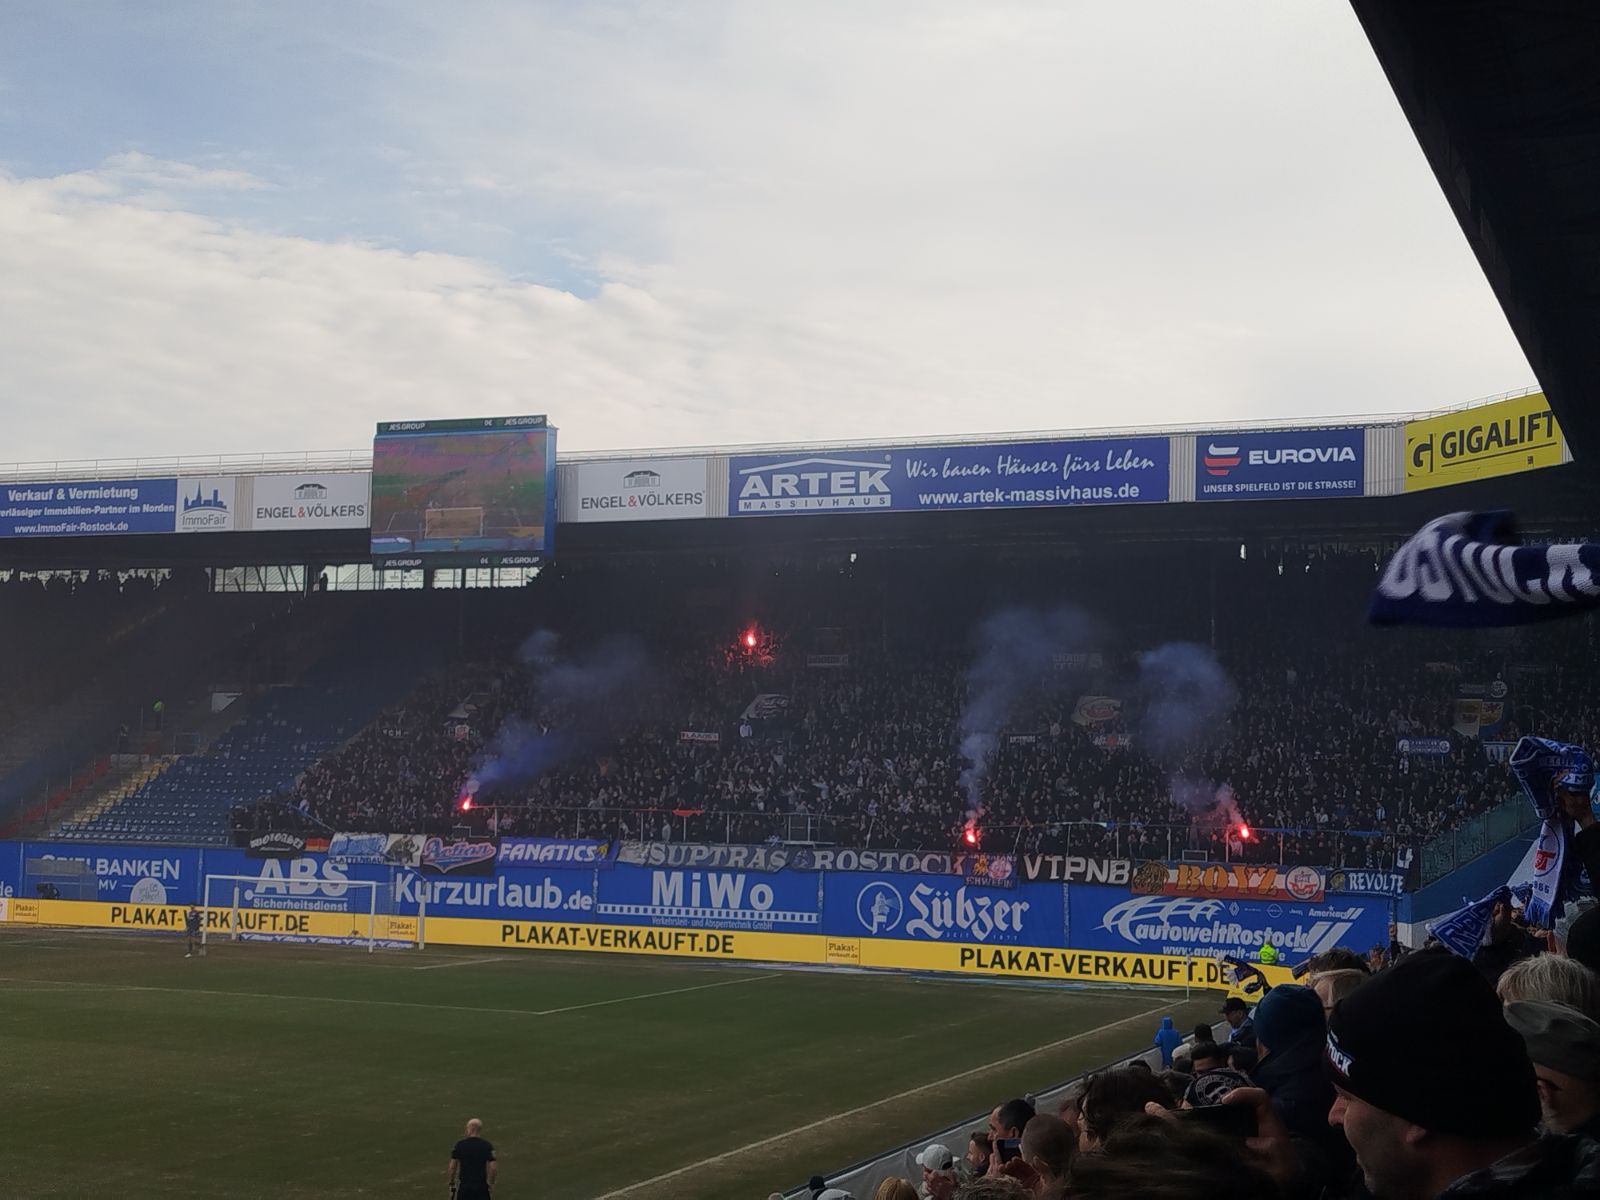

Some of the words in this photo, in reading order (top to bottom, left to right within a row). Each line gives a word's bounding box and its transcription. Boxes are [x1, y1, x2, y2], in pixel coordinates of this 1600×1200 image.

[1441, 410, 1554, 459] GIGALIFT
[905, 458, 938, 479] Wir
[942, 458, 991, 478] bauen
[997, 454, 1058, 477] Häuser
[1062, 454, 1101, 481] fürs
[1105, 448, 1155, 471] Leben
[1248, 445, 1356, 466] EUROVIA
[8, 488, 54, 502] Verkauf
[56, 488, 65, 500] &
[68, 486, 139, 500] Vermietung
[739, 469, 891, 498] ARTEK
[919, 483, 1140, 505] www.artek-massivhaus.de
[1203, 483, 1233, 493] UNSER
[1235, 482, 1280, 492] SPIELFELD
[1282, 482, 1296, 491] IST
[1298, 481, 1313, 491] DIE
[1315, 480, 1357, 490] STRASSE!
[0, 507, 43, 518] erlässiger
[44, 505, 127, 516] Immobilien-Partner
[129, 504, 141, 514] im
[142, 503, 175, 513] Norden
[743, 497, 886, 509] MASSIVHAUS
[14, 521, 129, 533] www.ImmoFair-Rostock.de
[182, 514, 227, 526] ImmoFair
[498, 843, 597, 863] FANATICS
[648, 843, 788, 872] SUPTRAS
[811, 850, 965, 875] ROSTOCK
[254, 858, 348, 897] ABS
[1023, 854, 1131, 885] VTPNB
[1176, 863, 1278, 896] BOYZ
[98, 880, 117, 891] MV
[395, 872, 593, 912] Kurzurlaub.de
[652, 870, 774, 911] MiWo
[1348, 872, 1404, 893] REVOLTE
[253, 897, 348, 912] Sicherheitsdienst
[905, 882, 1030, 941] Lübzer
[691, 918, 703, 927] und
[752, 921, 773, 930] GmbH
[1135, 920, 1309, 949] autoweltRostock
[501, 924, 734, 954] PLAKAT-VERKAUFT.DE
[960, 947, 1230, 984] PLAKAT-VERKAUFT.DE
